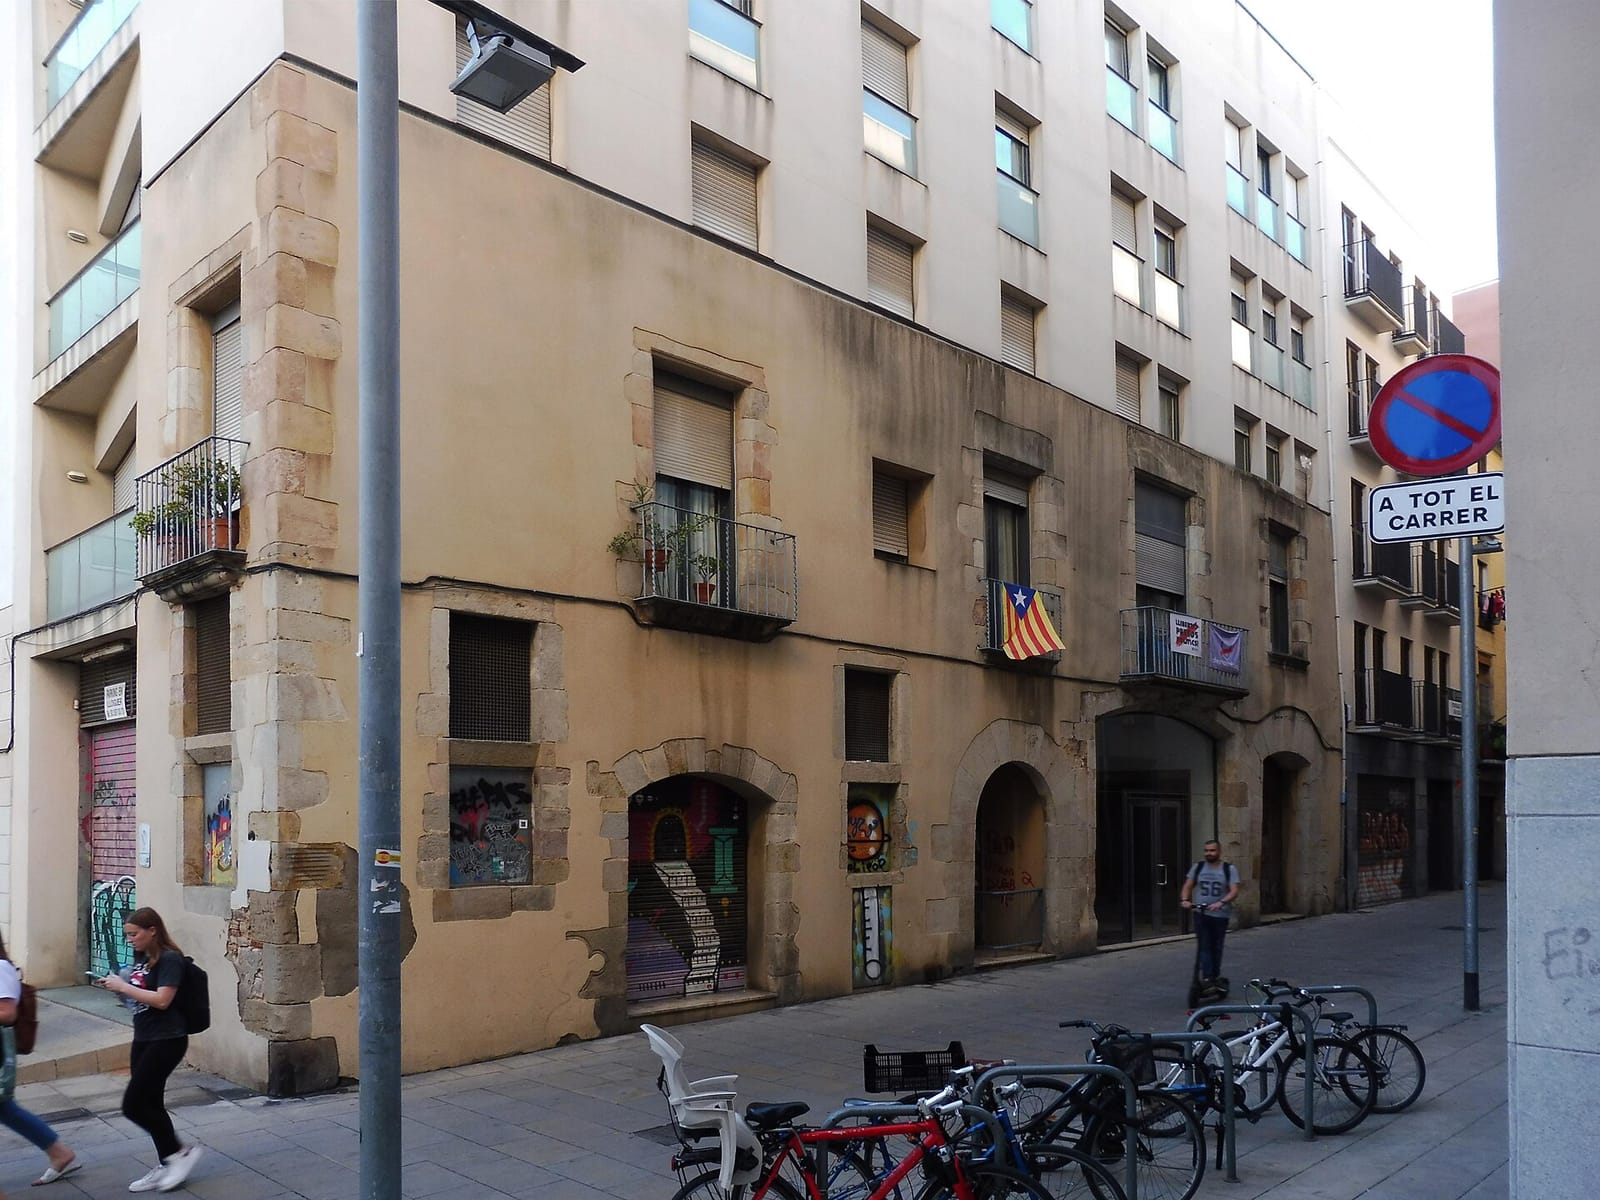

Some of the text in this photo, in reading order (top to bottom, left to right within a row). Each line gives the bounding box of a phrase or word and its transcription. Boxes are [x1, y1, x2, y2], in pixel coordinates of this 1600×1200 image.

[1379, 485, 1499, 512] A TOT EL
[1389, 507, 1488, 530] CARRER
[1199, 880, 1222, 897] 56
